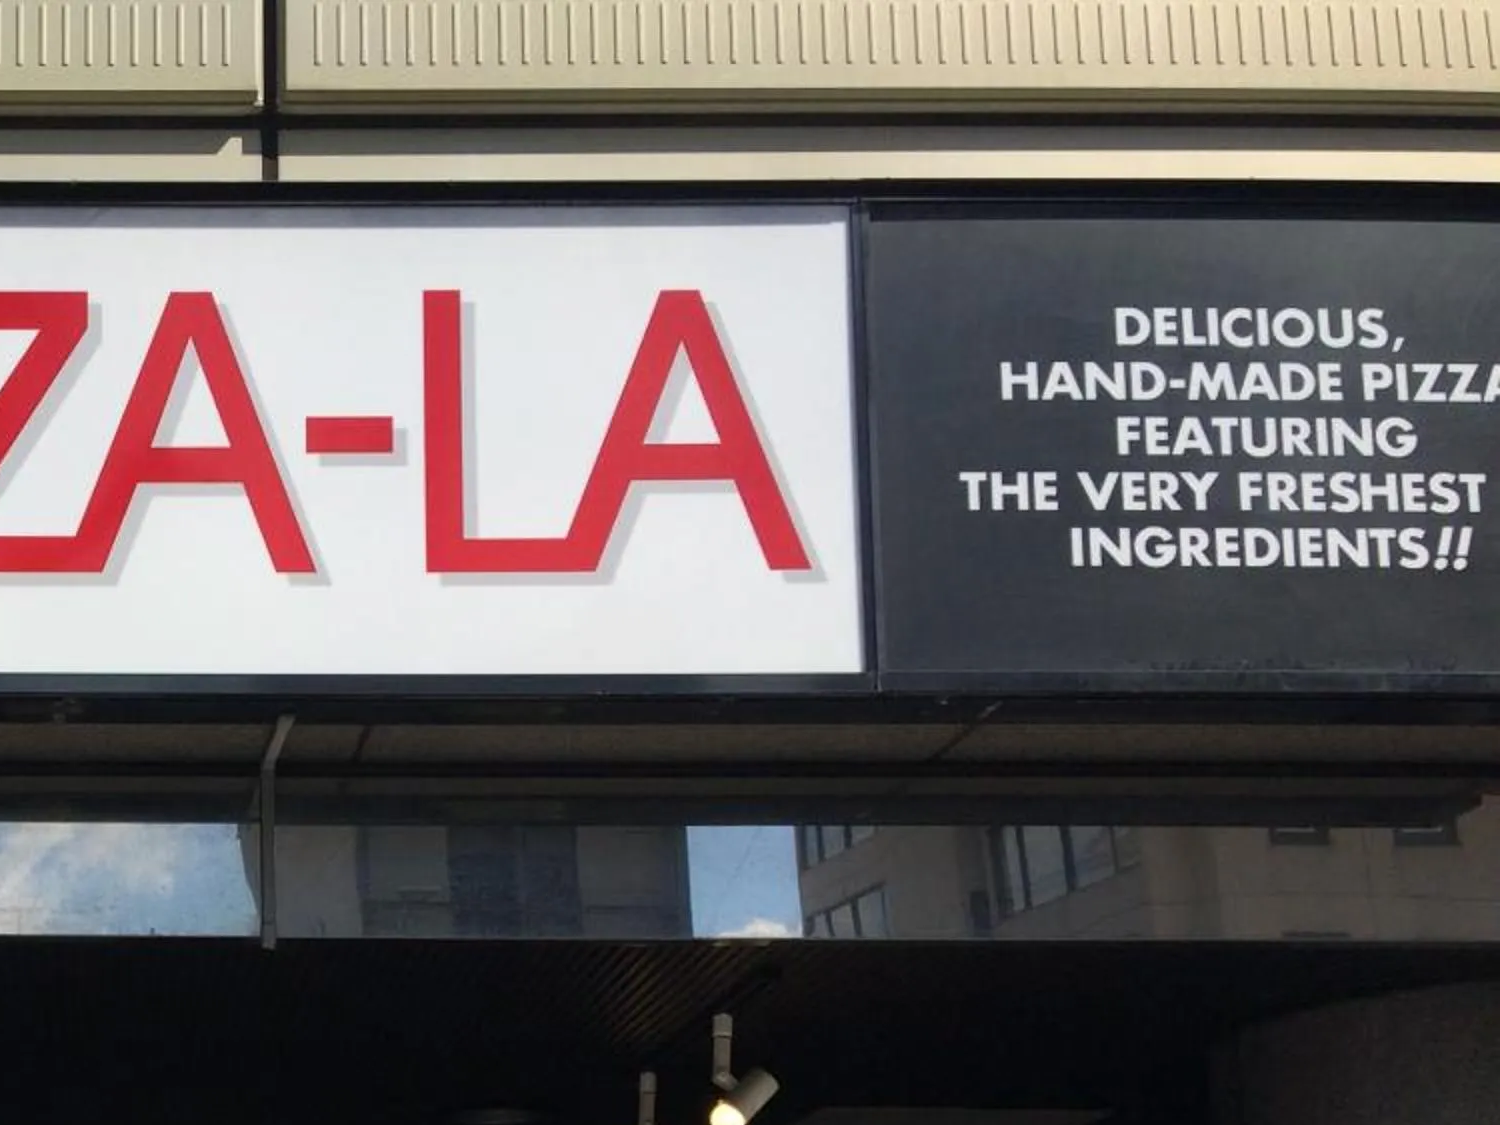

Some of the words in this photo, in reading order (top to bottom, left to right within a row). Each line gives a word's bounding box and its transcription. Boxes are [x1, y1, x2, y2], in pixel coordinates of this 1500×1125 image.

[1115, 307, 1405, 352] DELICIOUS,
[1001, 362, 1344, 402] HAND-MADE
[1116, 416, 1419, 458] FEATURING
[959, 472, 1059, 511] THE
[1077, 472, 1219, 511] VERY
[1238, 472, 1487, 513] FRESHEST
[1070, 526, 1473, 571] INGREDIENTS!!
